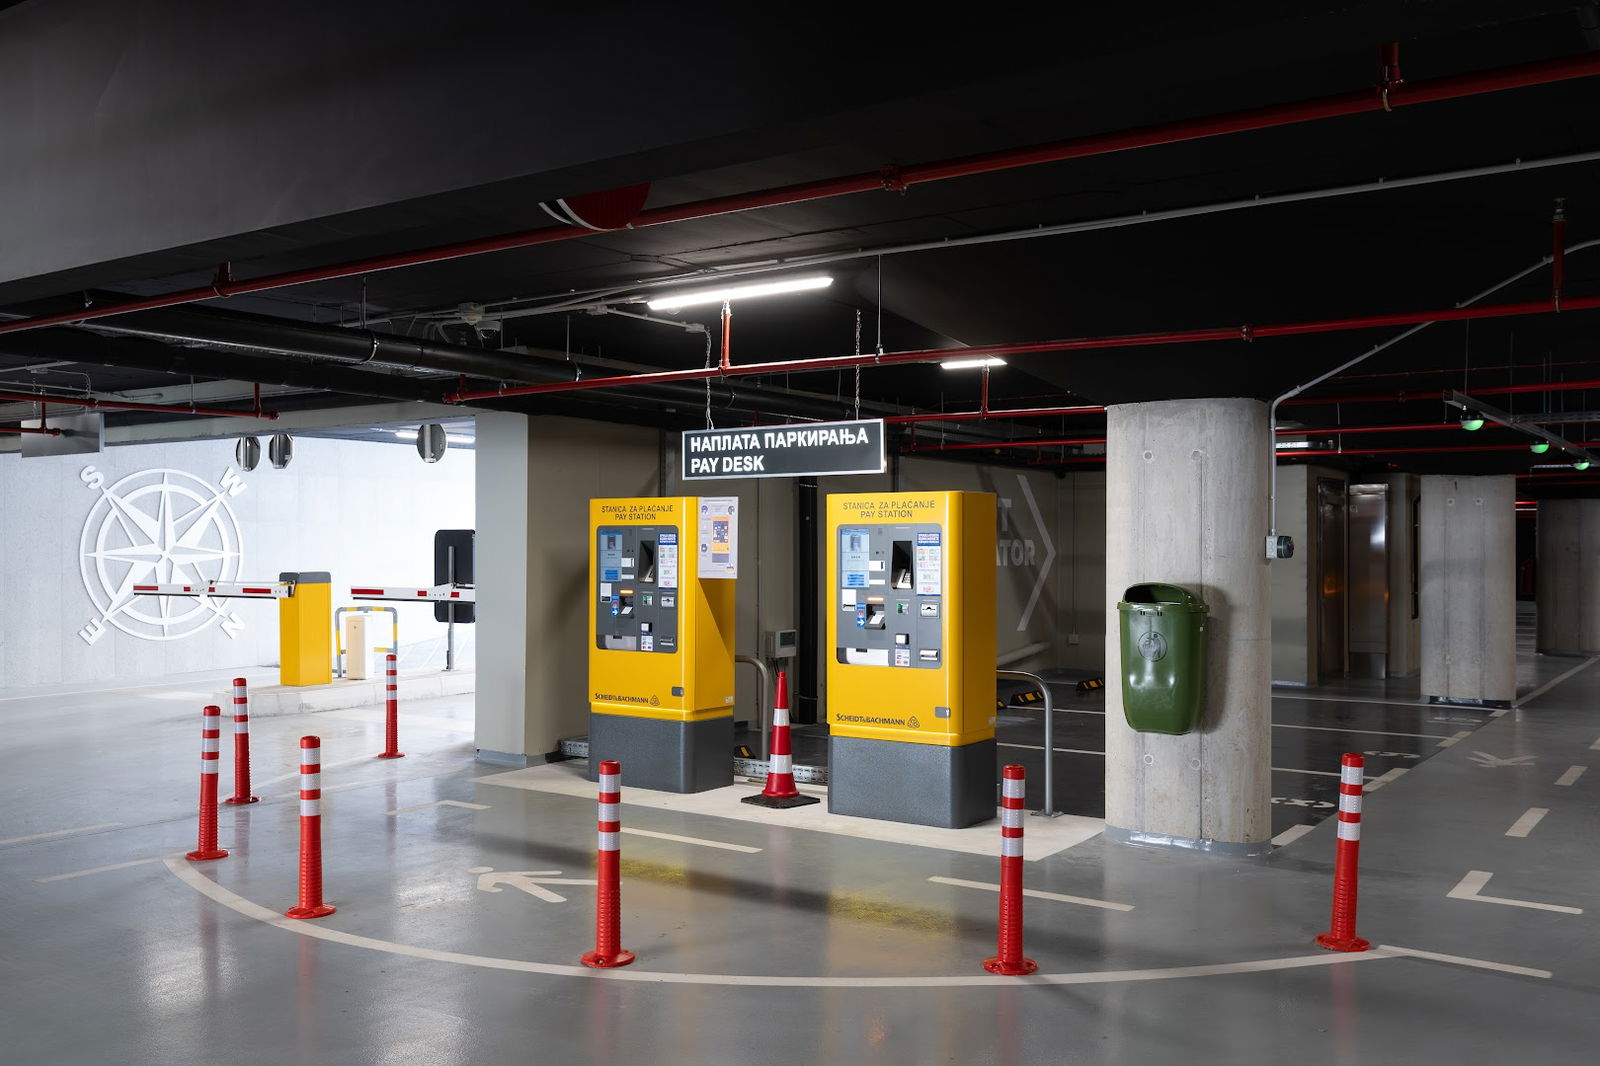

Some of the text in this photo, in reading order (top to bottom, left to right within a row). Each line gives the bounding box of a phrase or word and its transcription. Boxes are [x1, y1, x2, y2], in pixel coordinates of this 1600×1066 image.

[690, 427, 869, 452] НАПЛАТА ПАРКИРАЊА
[690, 455, 765, 473] PAY DESK
[80, 465, 105, 490] S
[219, 466, 248, 497] W
[601, 505, 627, 513] STANICA
[629, 504, 640, 512] ZA
[842, 501, 875, 510] STANICA
[878, 501, 889, 509] ZA
[860, 509, 913, 519] PAY STATION
[614, 513, 628, 521] PAY
[77, 617, 107, 647] E
[219, 611, 246, 640] N
